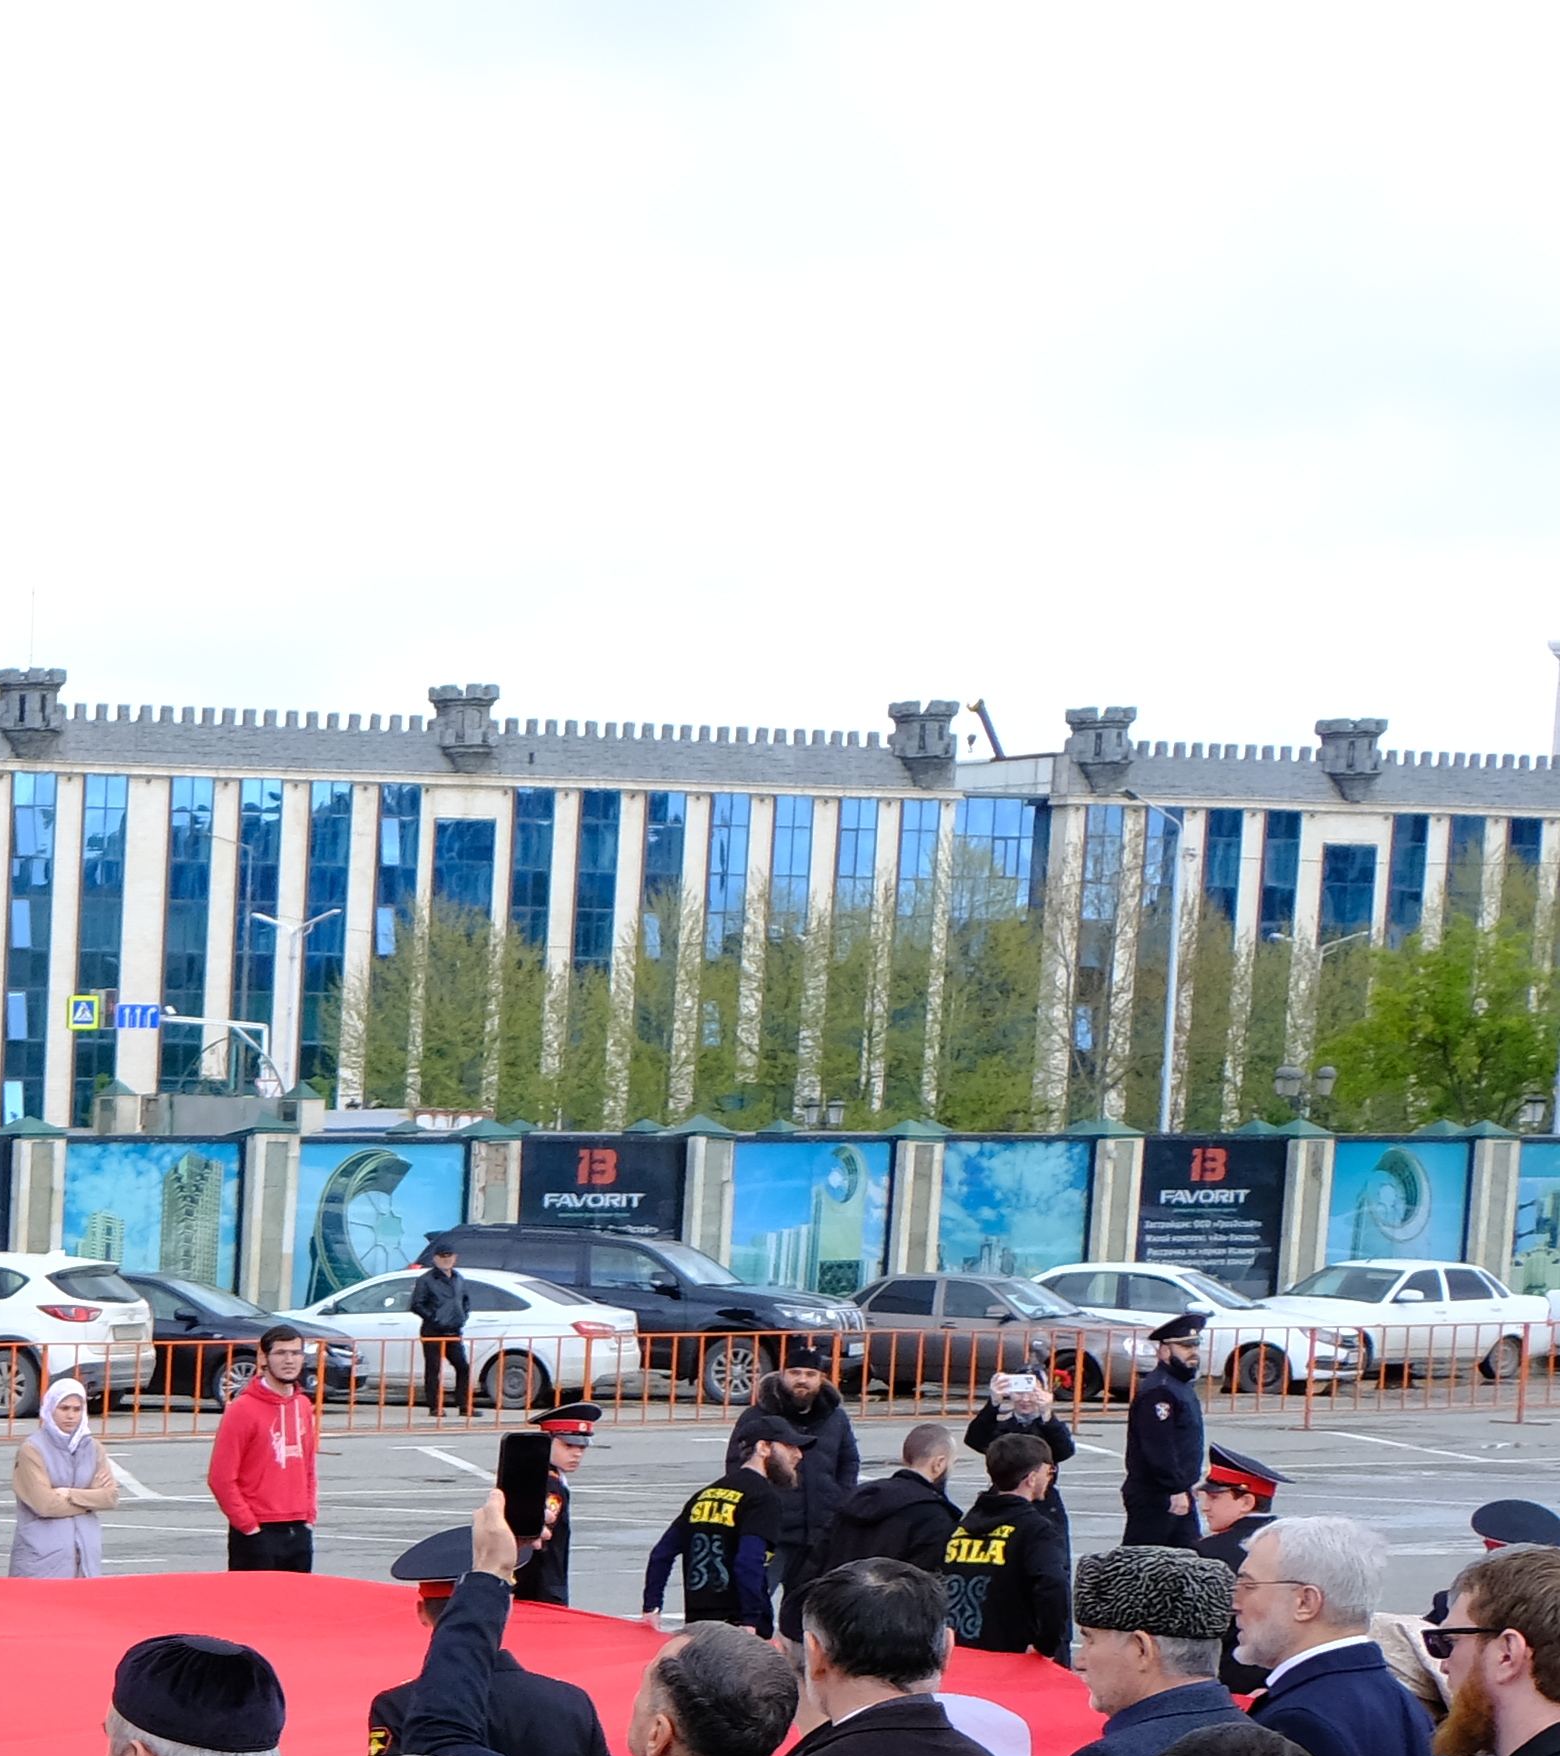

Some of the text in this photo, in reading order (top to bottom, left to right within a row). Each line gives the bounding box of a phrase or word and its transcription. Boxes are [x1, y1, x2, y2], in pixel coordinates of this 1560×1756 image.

[543, 1193, 647, 1209] FAVORIT
[1160, 1189, 1251, 1204] FAVORIT
[689, 1500, 736, 1527] SILA
[944, 1538, 1006, 1565] SILA
